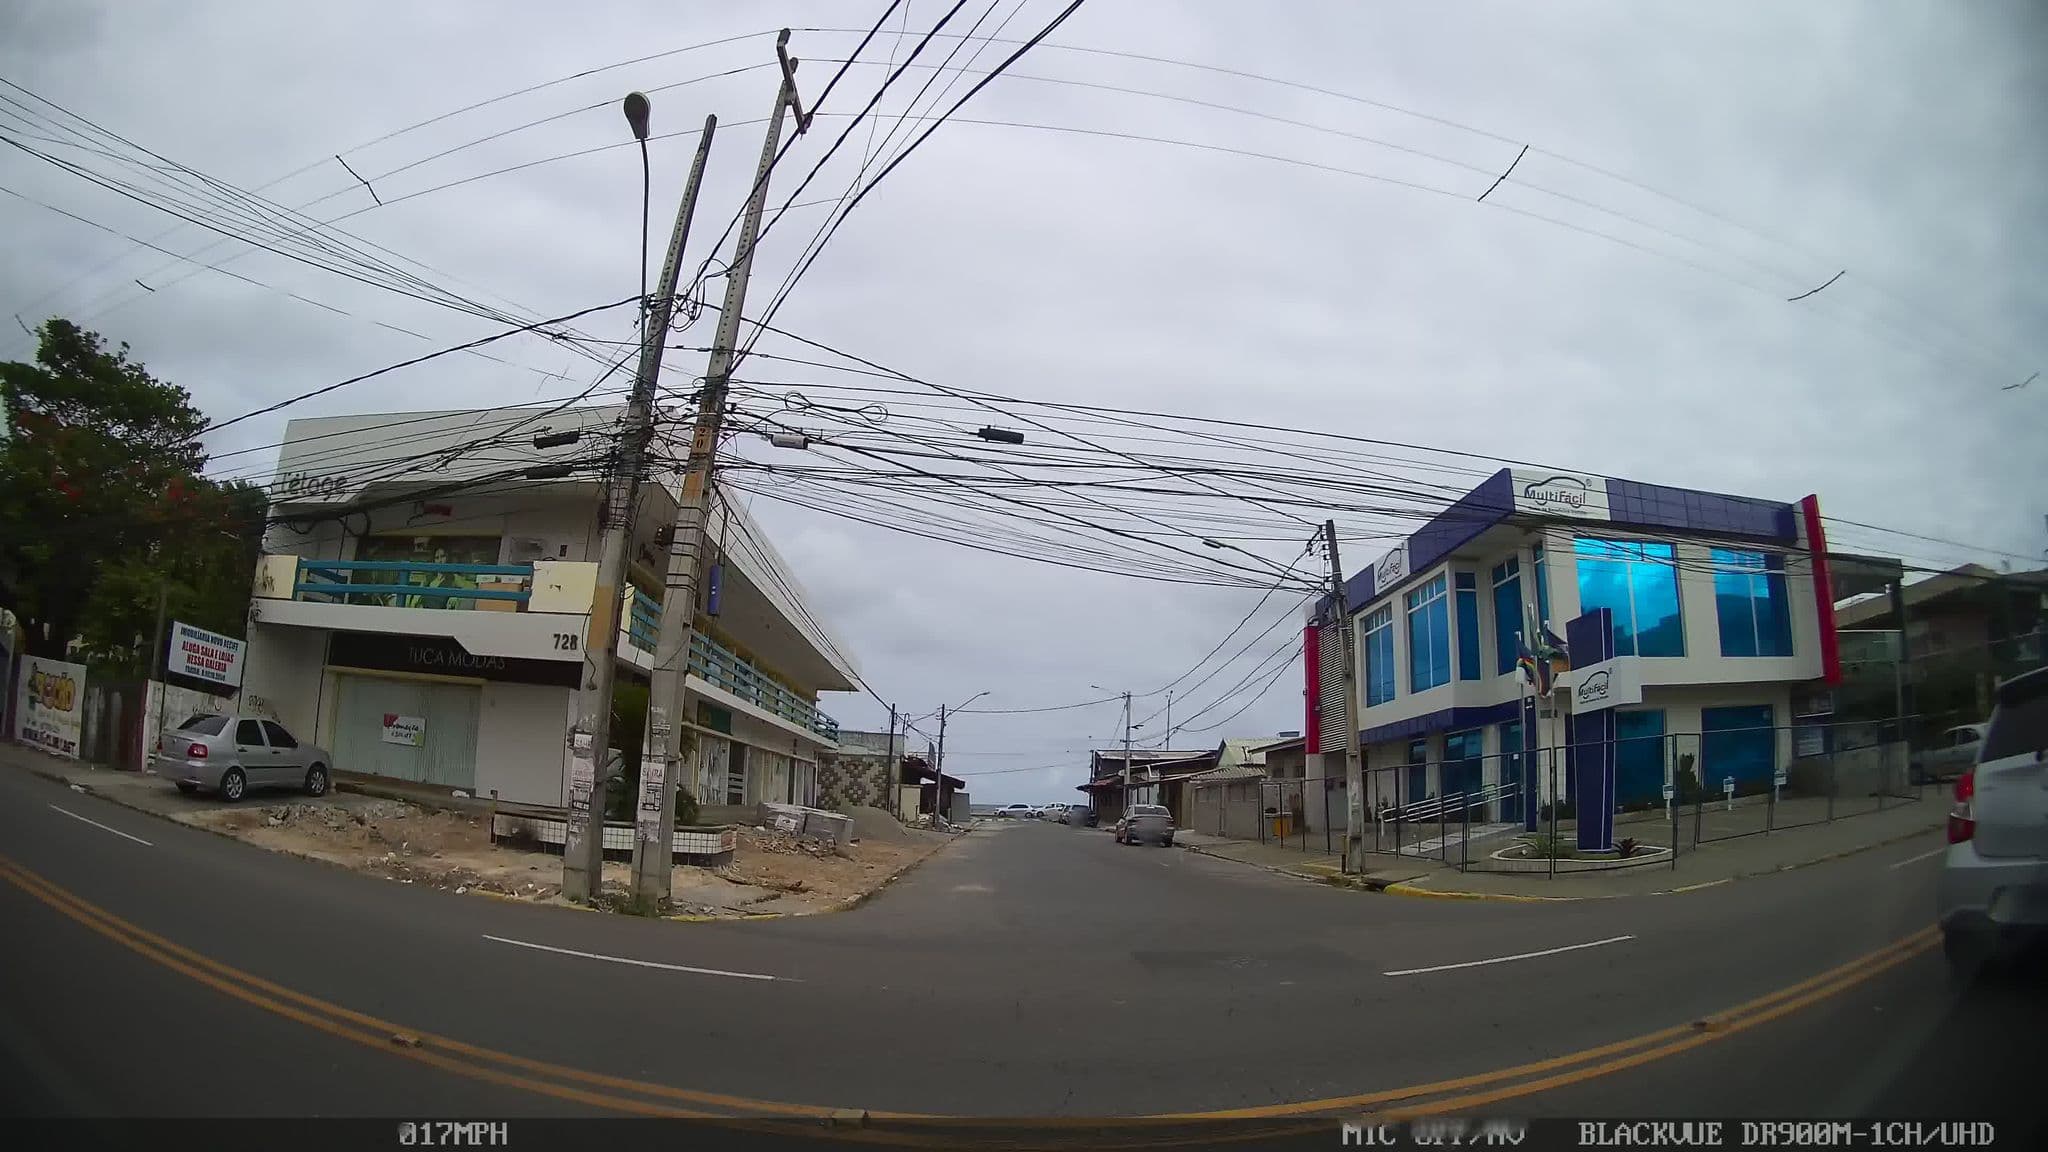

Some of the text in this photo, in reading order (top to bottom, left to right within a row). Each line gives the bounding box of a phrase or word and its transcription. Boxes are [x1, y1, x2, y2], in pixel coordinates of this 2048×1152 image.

[553, 633, 578, 650] 728
[182, 641, 200, 654] ALUGA
[200, 645, 214, 658] SALA
[219, 650, 235, 663] LOJAS
[409, 647, 506, 670] TUCA MODAS
[187, 654, 227, 672] NESSA GALERIA
